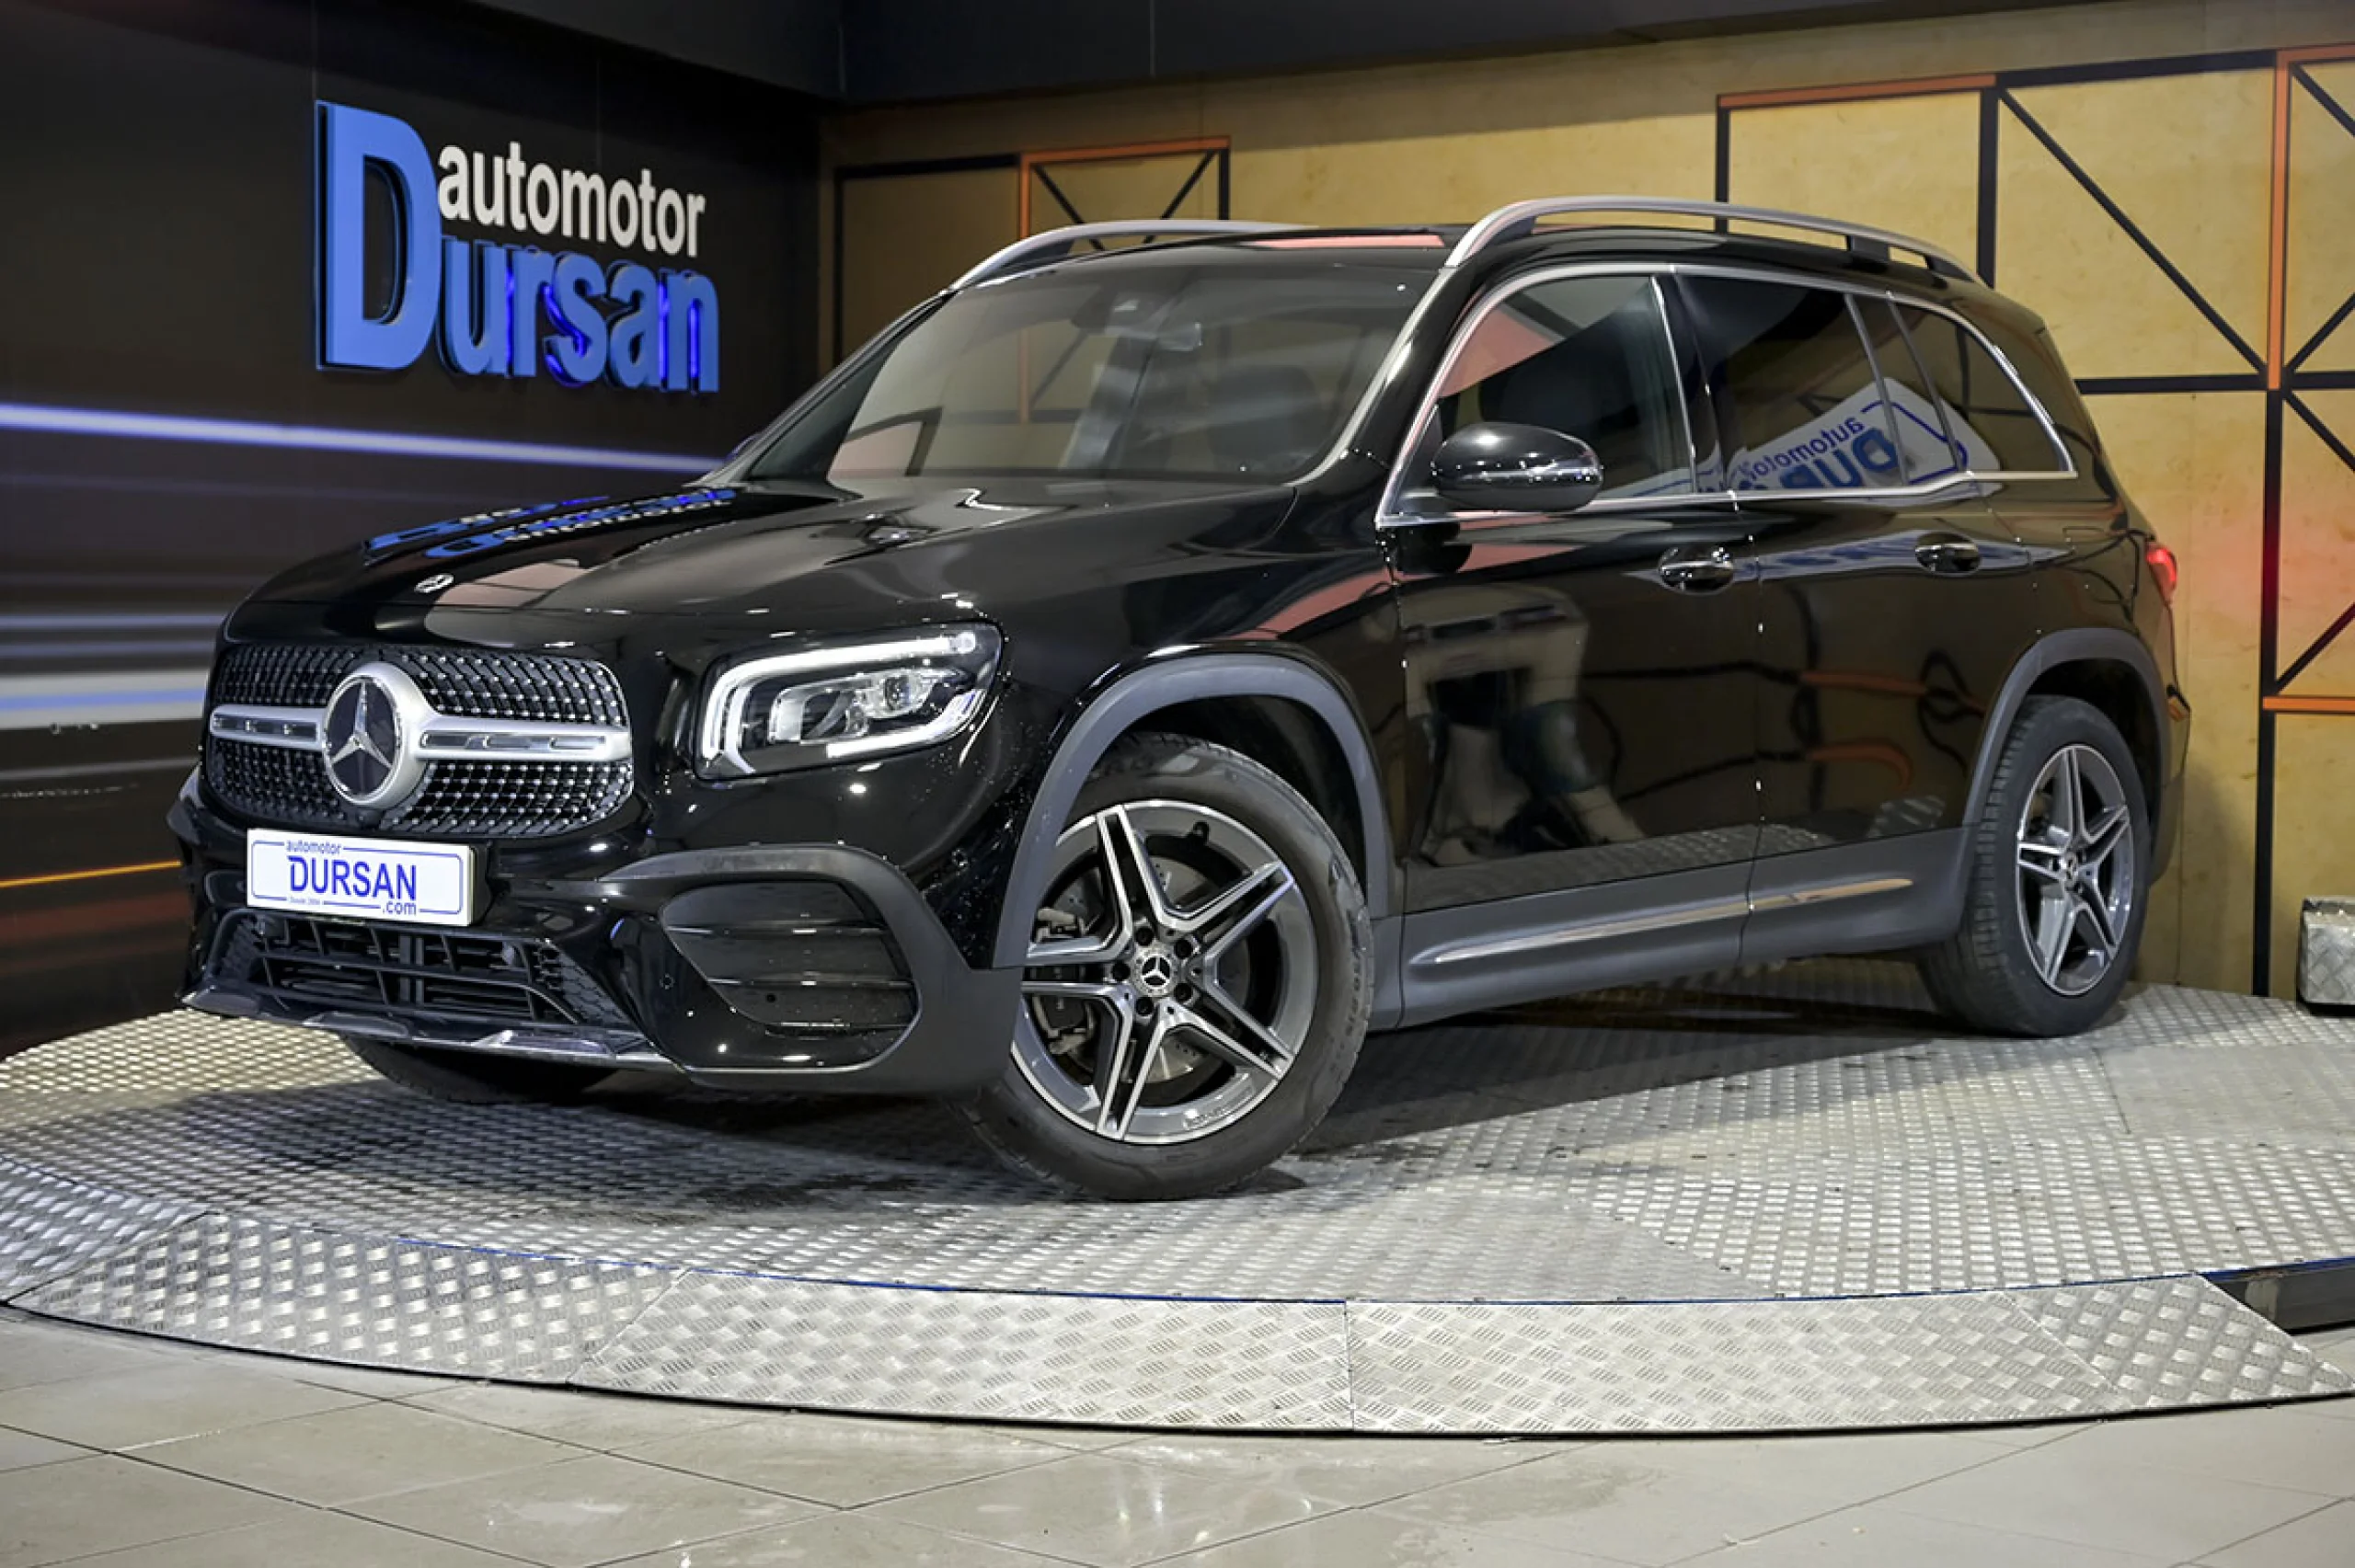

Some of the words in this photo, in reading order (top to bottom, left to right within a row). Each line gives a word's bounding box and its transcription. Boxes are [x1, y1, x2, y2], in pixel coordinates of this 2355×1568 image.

[437, 141, 706, 257] automotor
[316, 99, 720, 394] Dursan
[286, 840, 341, 854] automotor
[287, 855, 417, 901] DURSAN
[383, 900, 417, 915] .com
